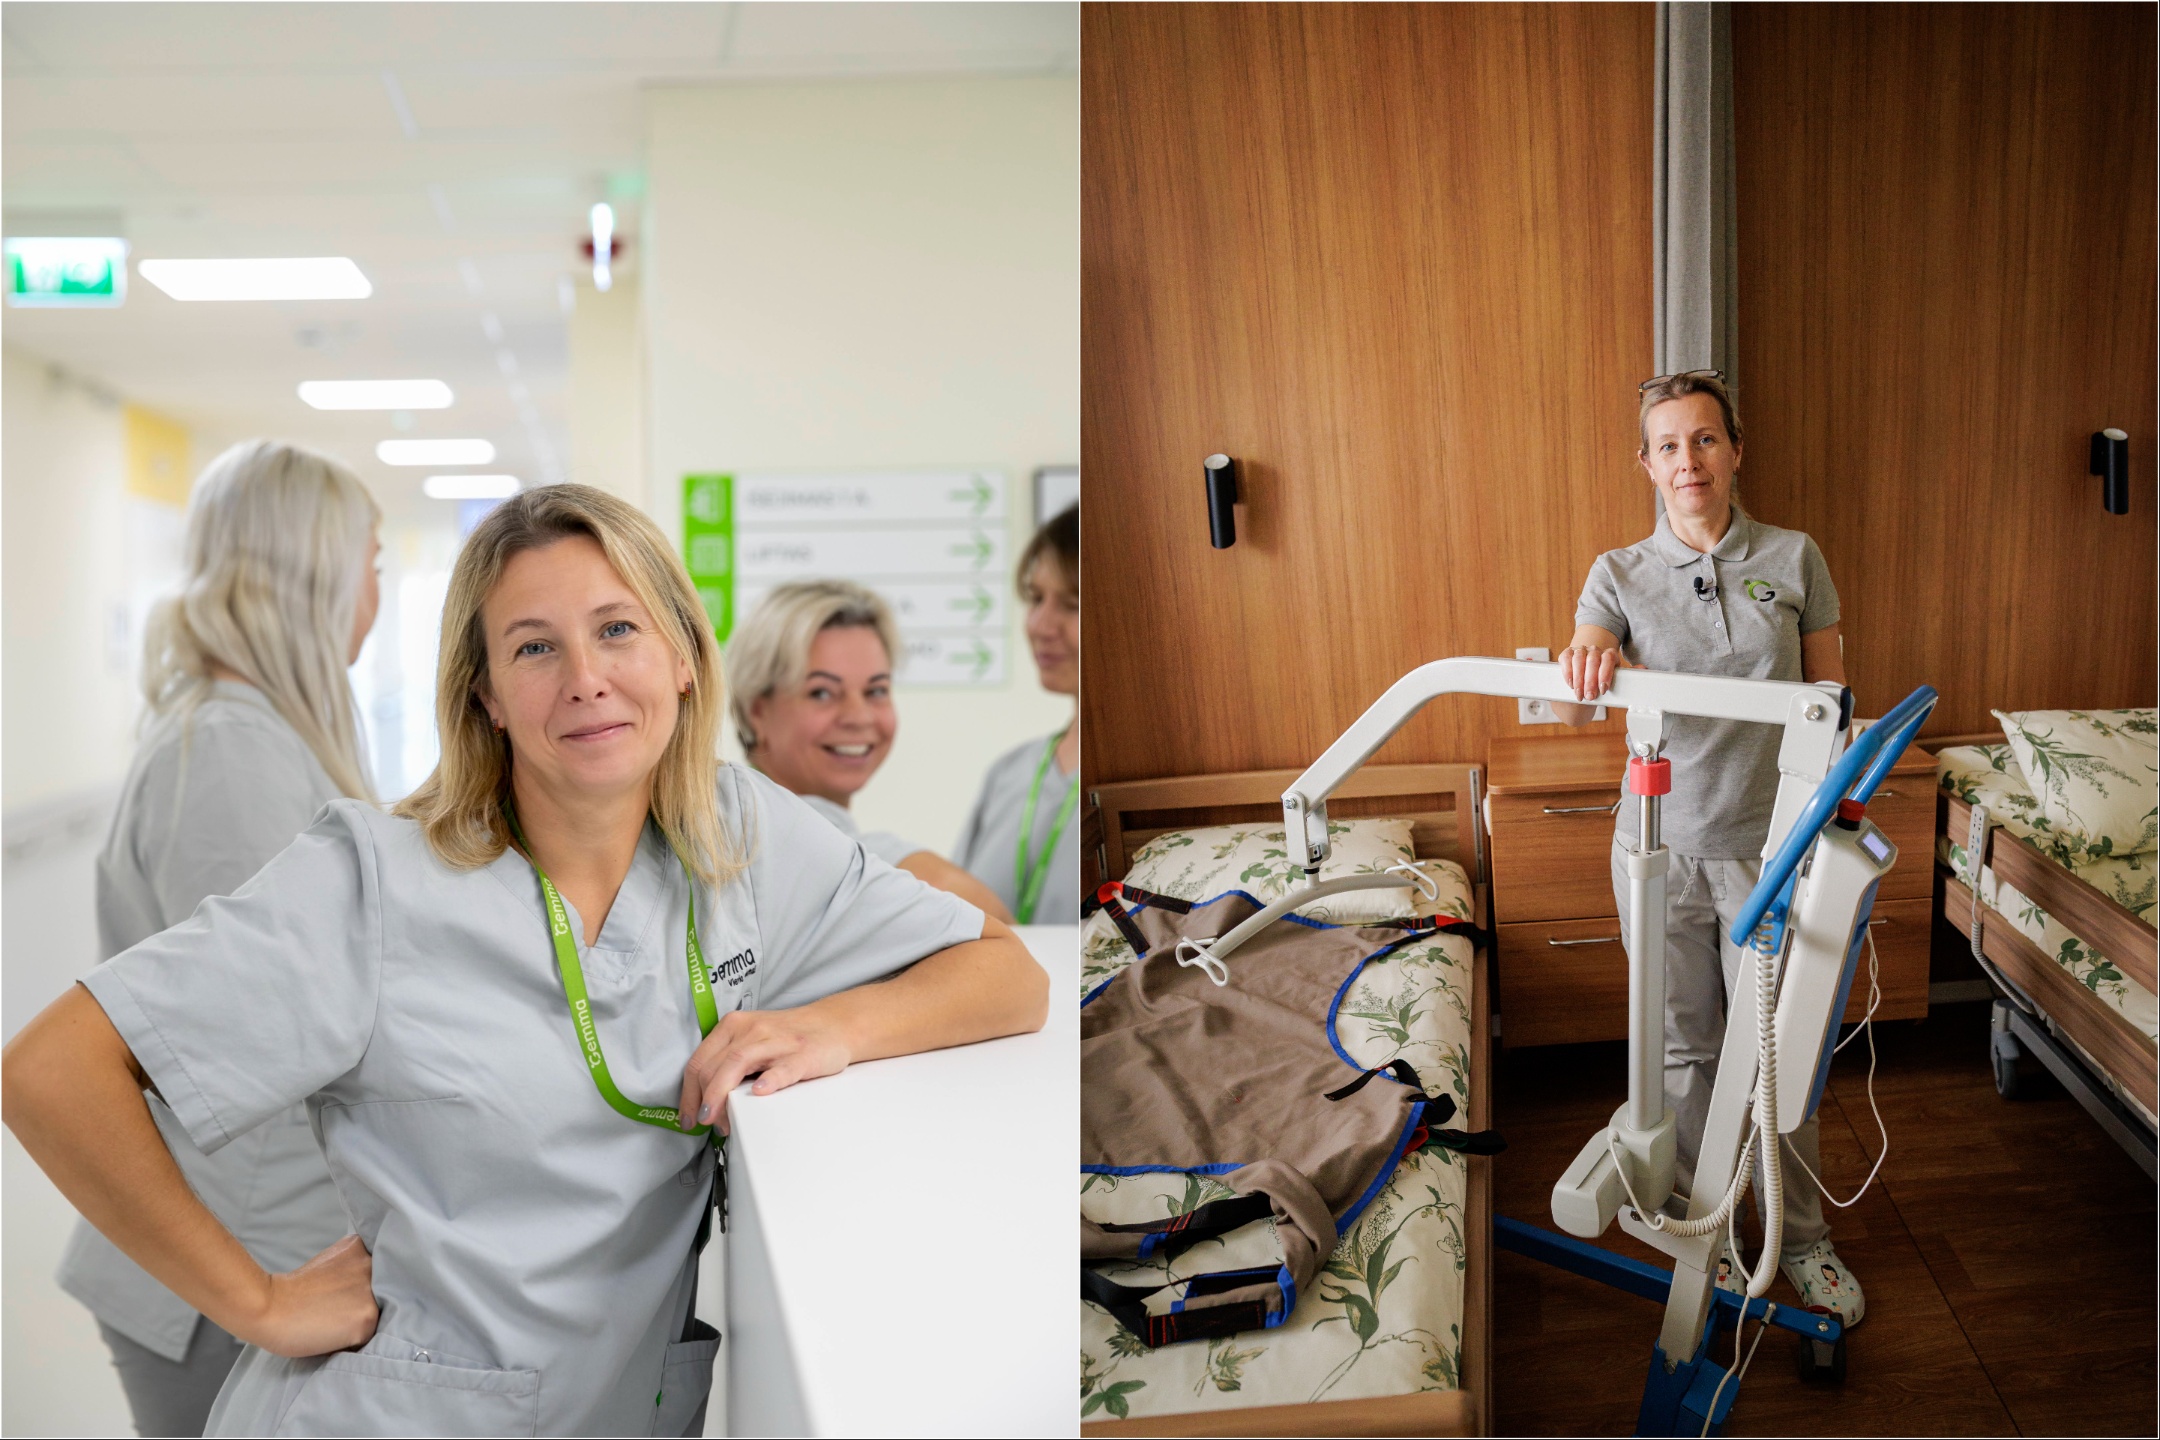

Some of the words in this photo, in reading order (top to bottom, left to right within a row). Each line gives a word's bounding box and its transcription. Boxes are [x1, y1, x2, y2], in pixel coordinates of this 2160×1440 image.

[543, 877, 568, 936] Gemma
[687, 927, 706, 994] Gemma
[575, 999, 602, 1068] Gemma
